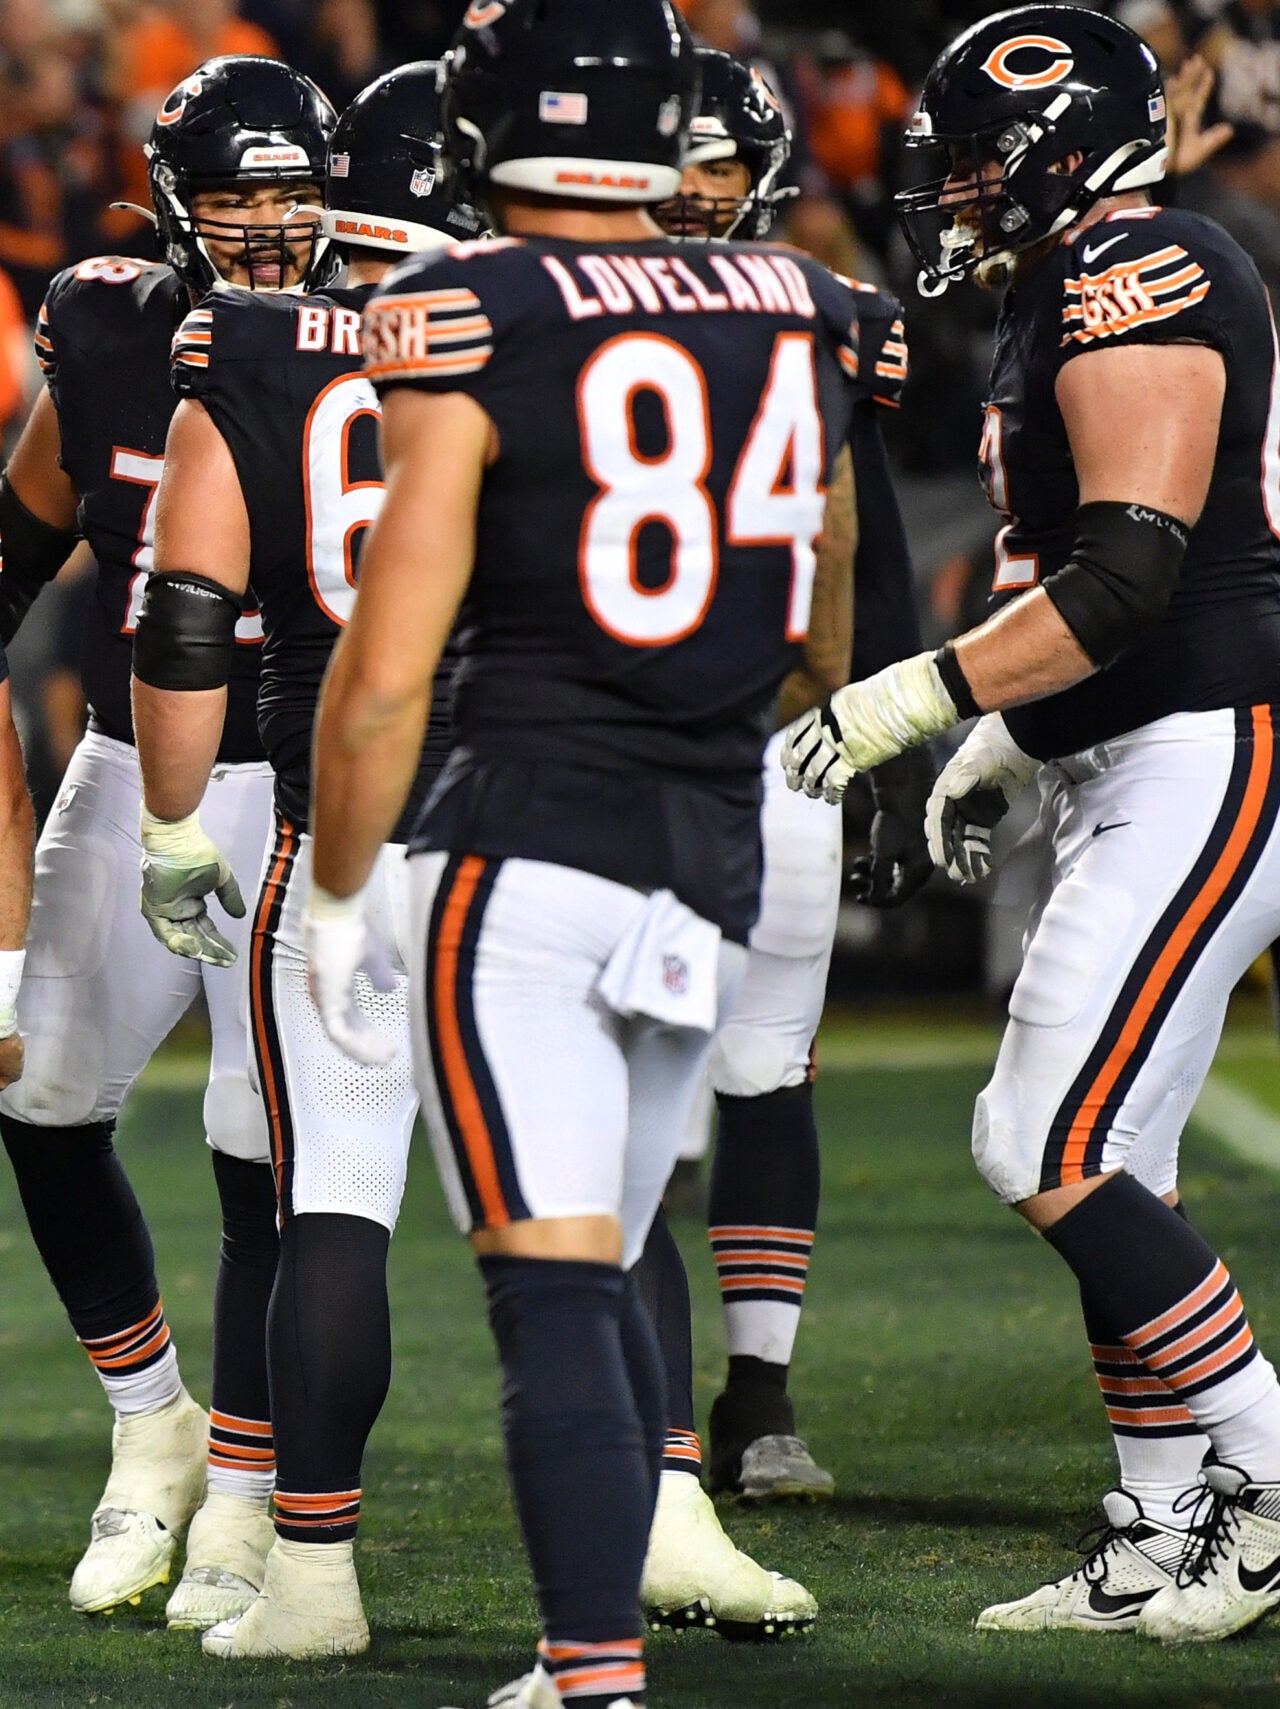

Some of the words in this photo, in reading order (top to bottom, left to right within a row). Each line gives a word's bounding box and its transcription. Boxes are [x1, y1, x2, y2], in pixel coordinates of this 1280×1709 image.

[253, 152, 300, 162] BEARS
[556, 171, 650, 190] BEARS
[335, 220, 409, 244] BEARS
[540, 253, 817, 321] LOVELAND
[1080, 271, 1156, 328] GSH
[575, 330, 827, 648] 84
